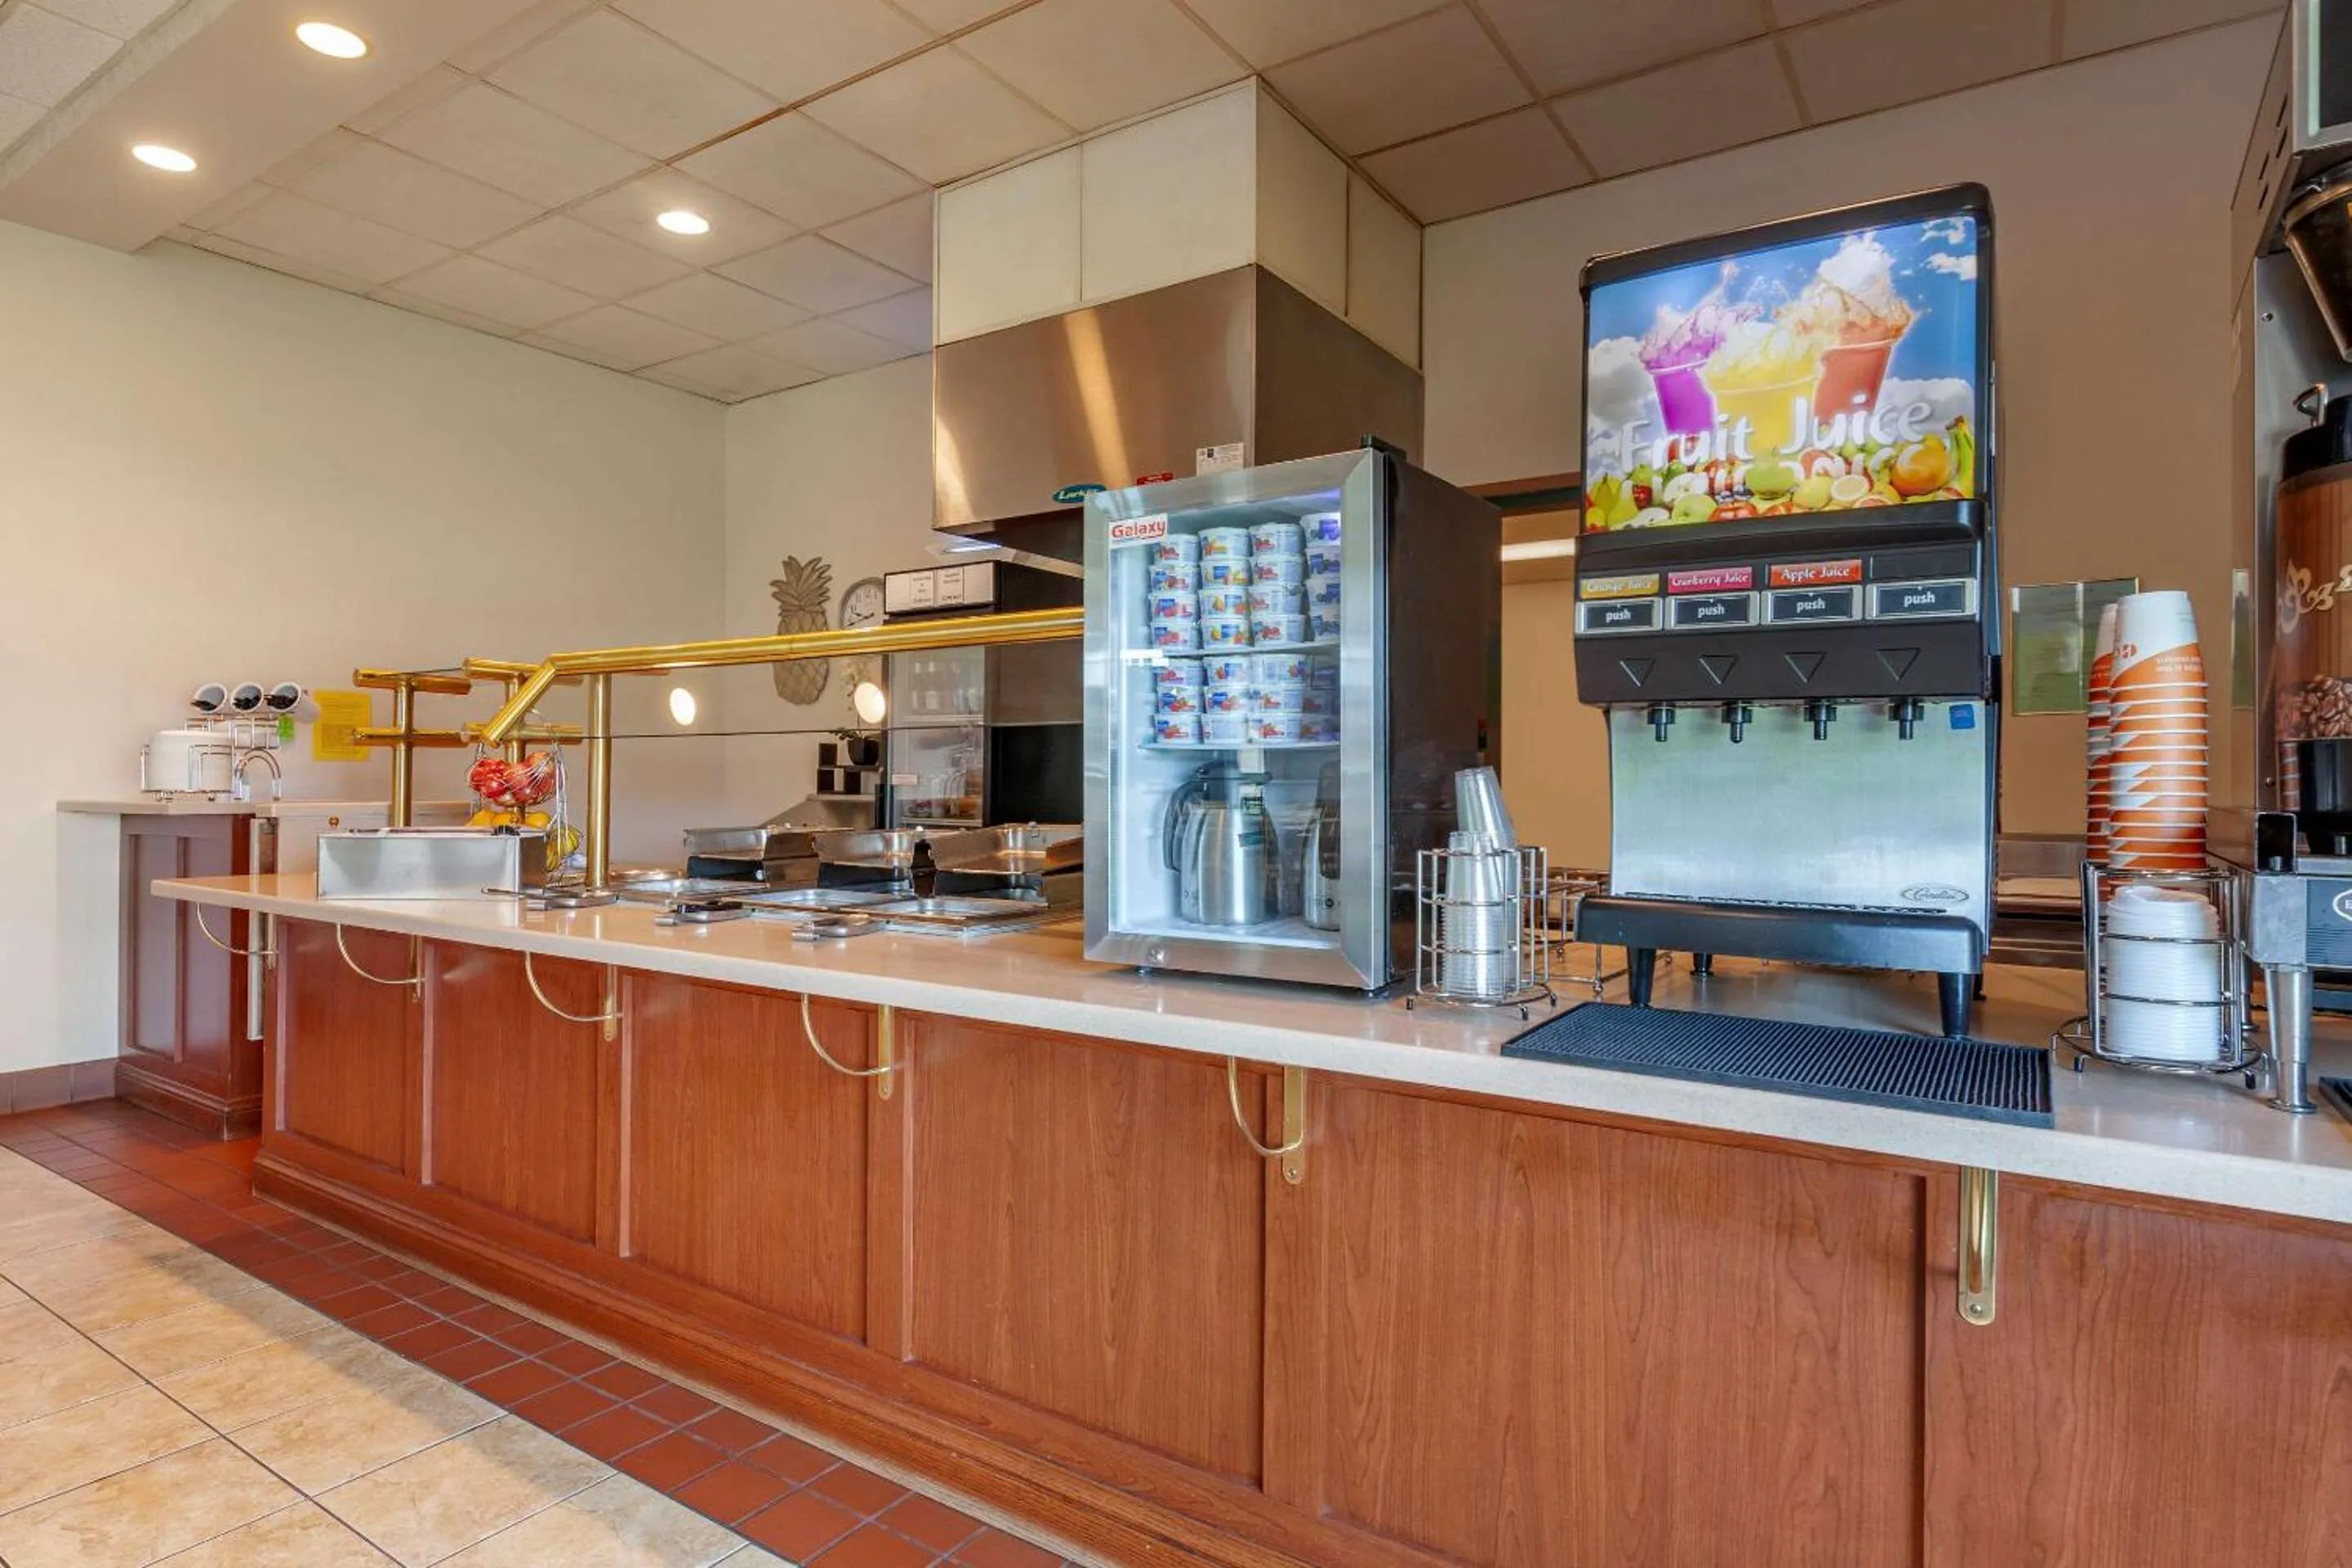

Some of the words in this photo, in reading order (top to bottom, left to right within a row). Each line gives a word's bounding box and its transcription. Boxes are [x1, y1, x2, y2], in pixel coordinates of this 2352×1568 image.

[1620, 413, 1753, 474] Fruit
[1780, 393, 1931, 453] Juice
[1111, 519, 1167, 539] Galaxy
[1780, 567, 1815, 582] Apple
[1820, 565, 1850, 578] Juice
[1796, 597, 1826, 613] push
[1904, 590, 1936, 608] push
[1605, 608, 1632, 623] push
[1698, 602, 1726, 618] push
